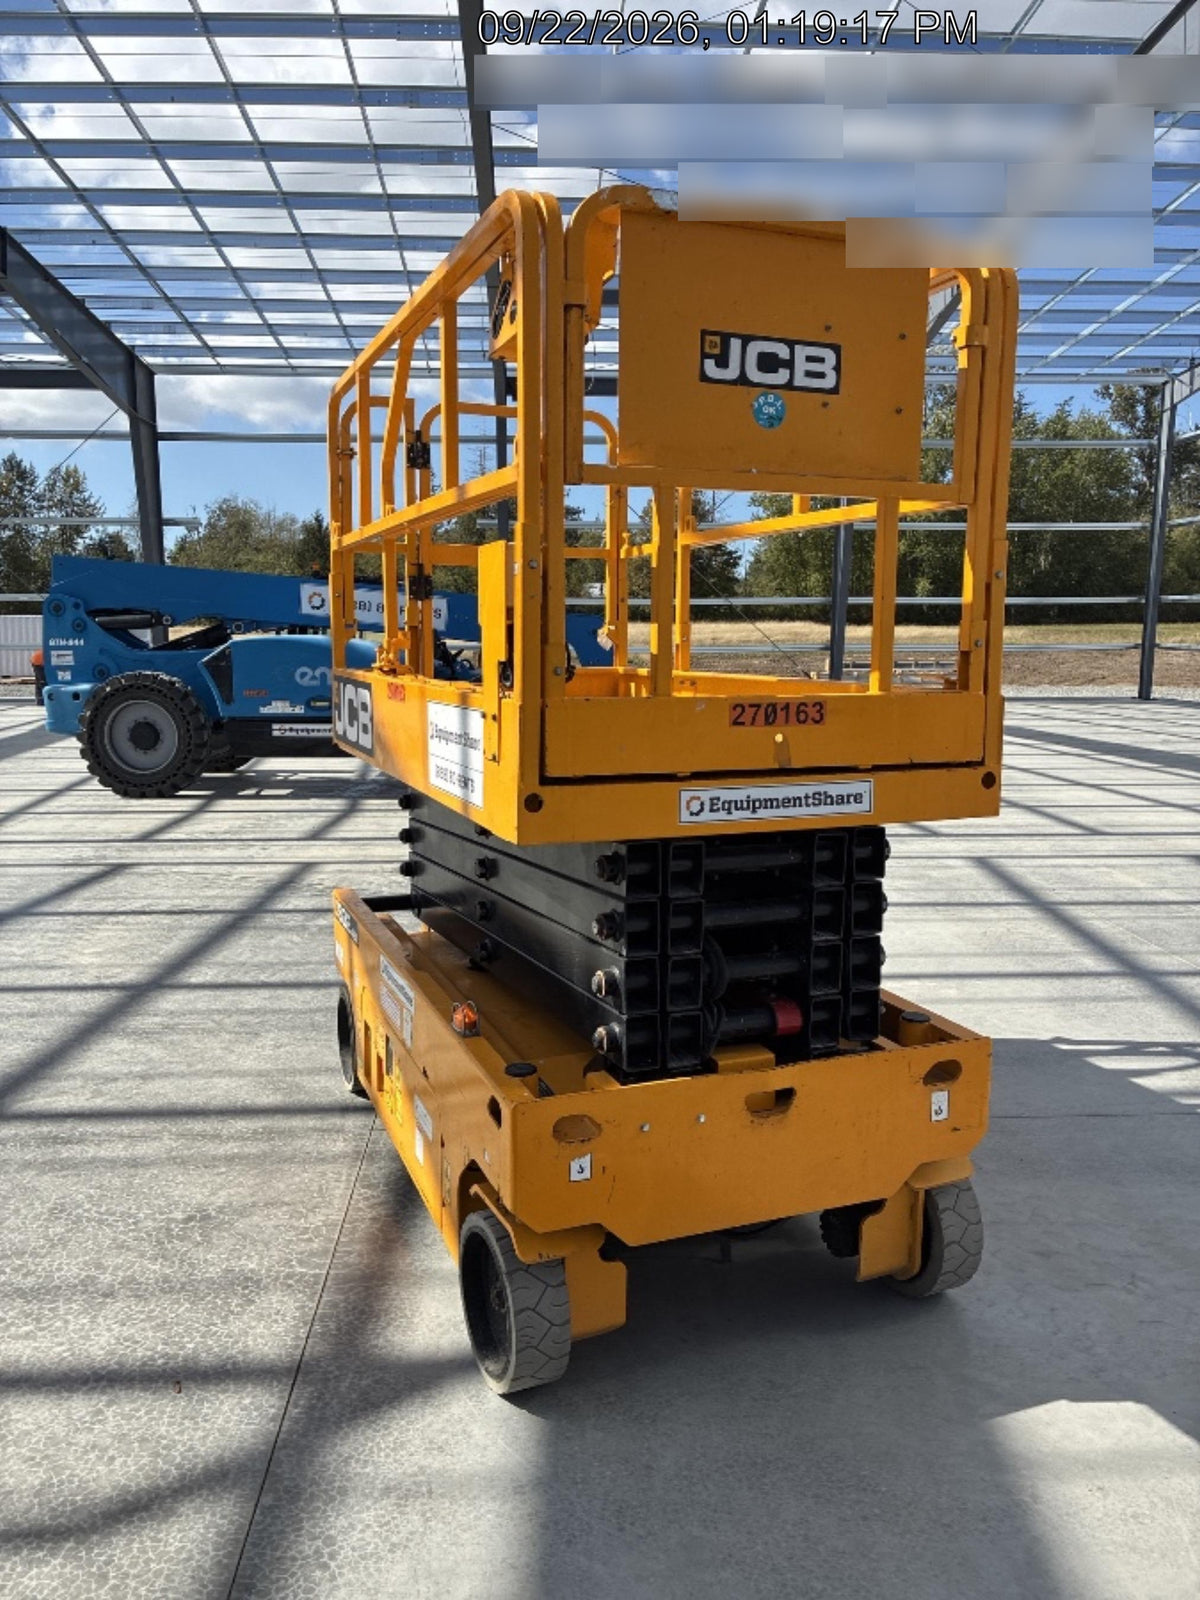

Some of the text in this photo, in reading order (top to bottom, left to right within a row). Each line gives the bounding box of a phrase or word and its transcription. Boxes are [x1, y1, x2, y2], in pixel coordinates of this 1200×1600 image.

[703, 337, 837, 389] JCB
[335, 681, 373, 750] JCB
[731, 701, 826, 726] 270163
[708, 790, 864, 815] EquipmentShare
